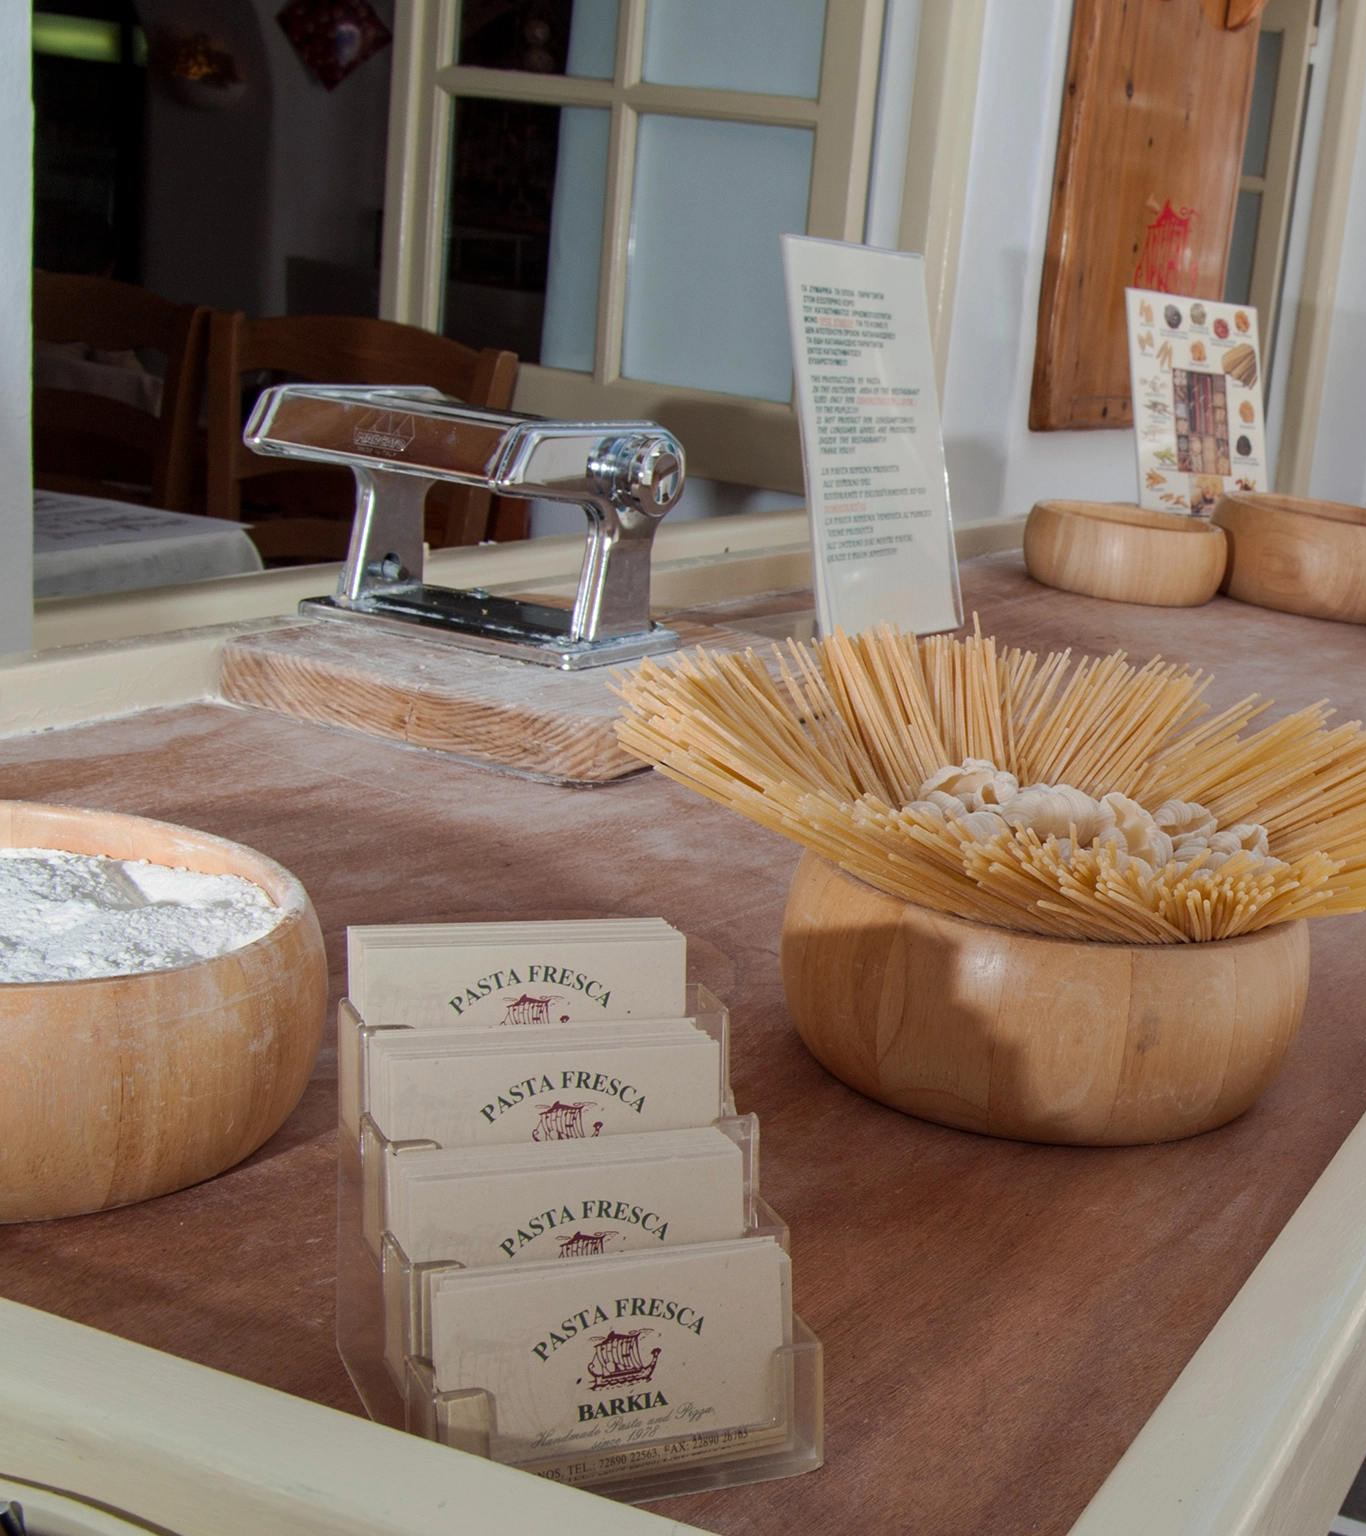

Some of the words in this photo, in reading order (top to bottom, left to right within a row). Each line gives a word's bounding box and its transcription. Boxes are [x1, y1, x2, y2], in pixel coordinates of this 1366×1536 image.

[448, 967, 523, 1015] PASTA
[528, 964, 612, 1009] FRESCA
[479, 1074, 556, 1124] PASTA
[561, 1070, 648, 1114] FRESCA
[498, 1204, 575, 1258] PASTA
[581, 1199, 670, 1241] FRESCA
[531, 1305, 610, 1363] PASTA
[614, 1297, 706, 1336] FRESCA
[577, 1390, 669, 1423] BARKIA
[531, 1427, 601, 1449] Handmade
[607, 1417, 644, 1434] Pasta
[647, 1412, 670, 1426] and
[590, 1438, 621, 1451] since
[627, 1426, 659, 1443] 1978
[599, 1454, 627, 1468] 22890
[630, 1449, 660, 1463] 22563,
[664, 1440, 690, 1455] FAX:
